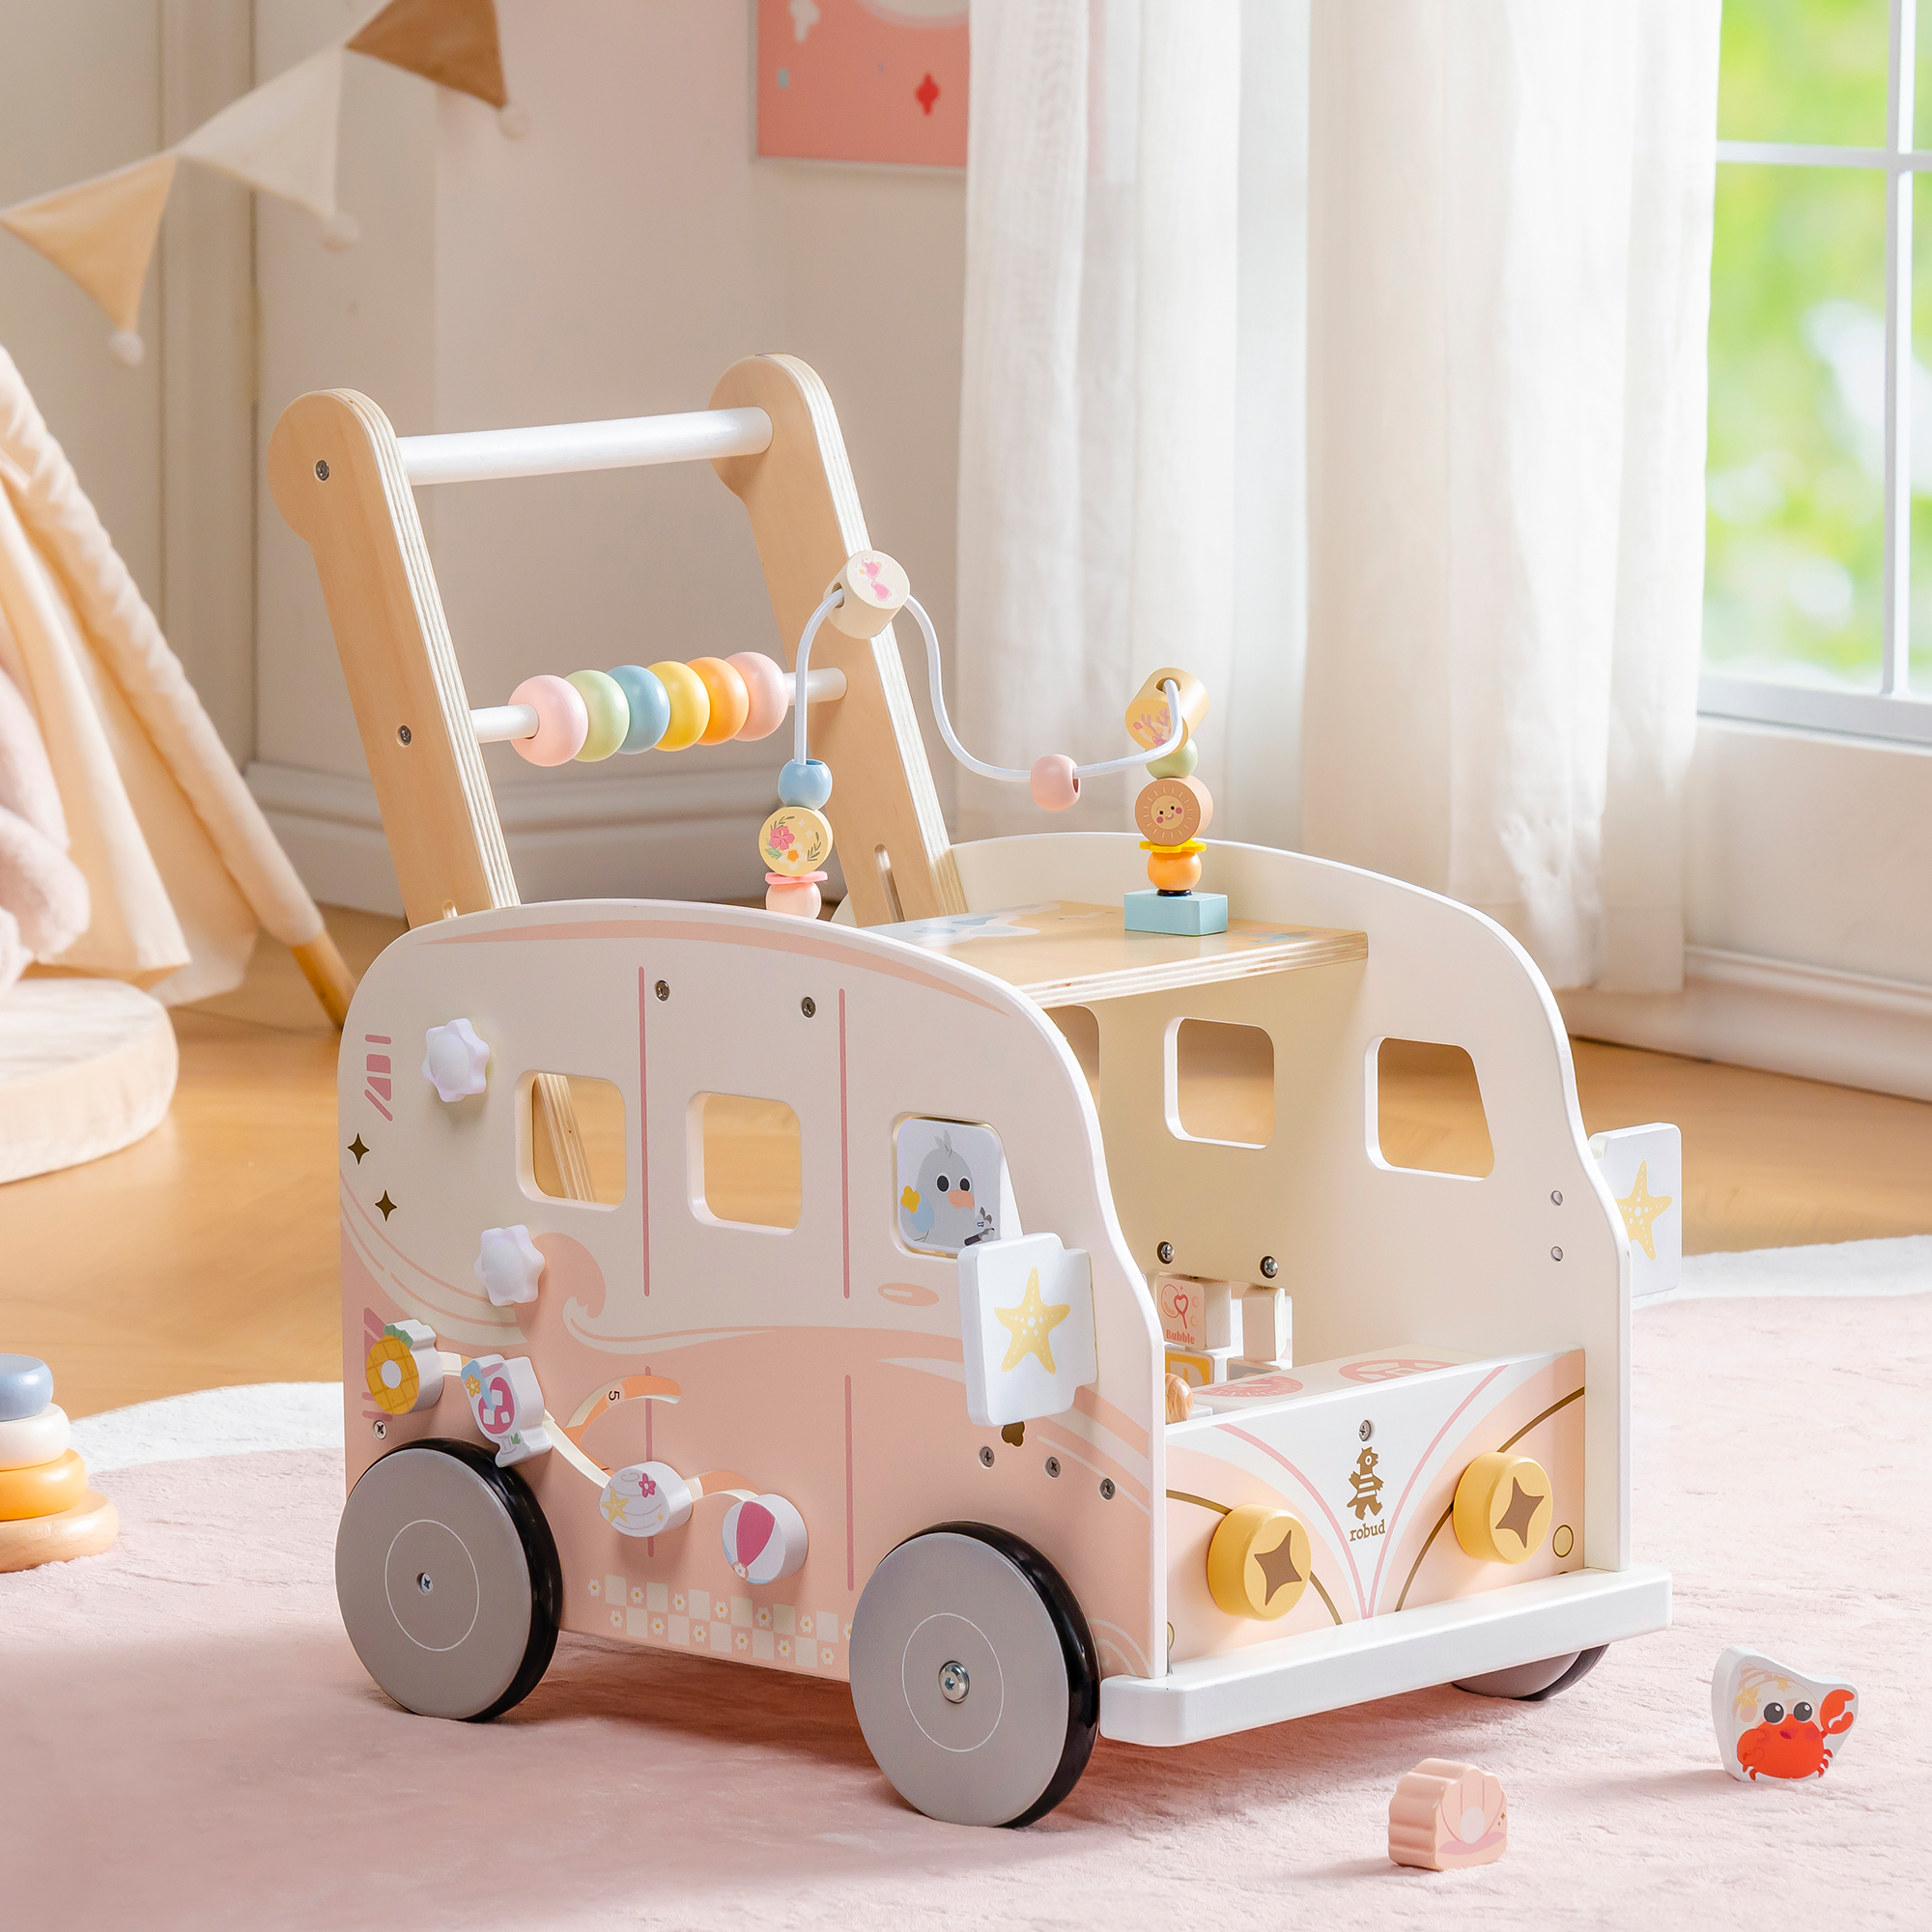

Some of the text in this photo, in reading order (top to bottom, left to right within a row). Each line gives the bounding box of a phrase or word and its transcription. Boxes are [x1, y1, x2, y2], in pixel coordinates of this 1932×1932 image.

[1166, 1328, 1196, 1345] Bubble
[609, 1391, 620, 1402] 5
[1349, 1518, 1386, 1543] robud
